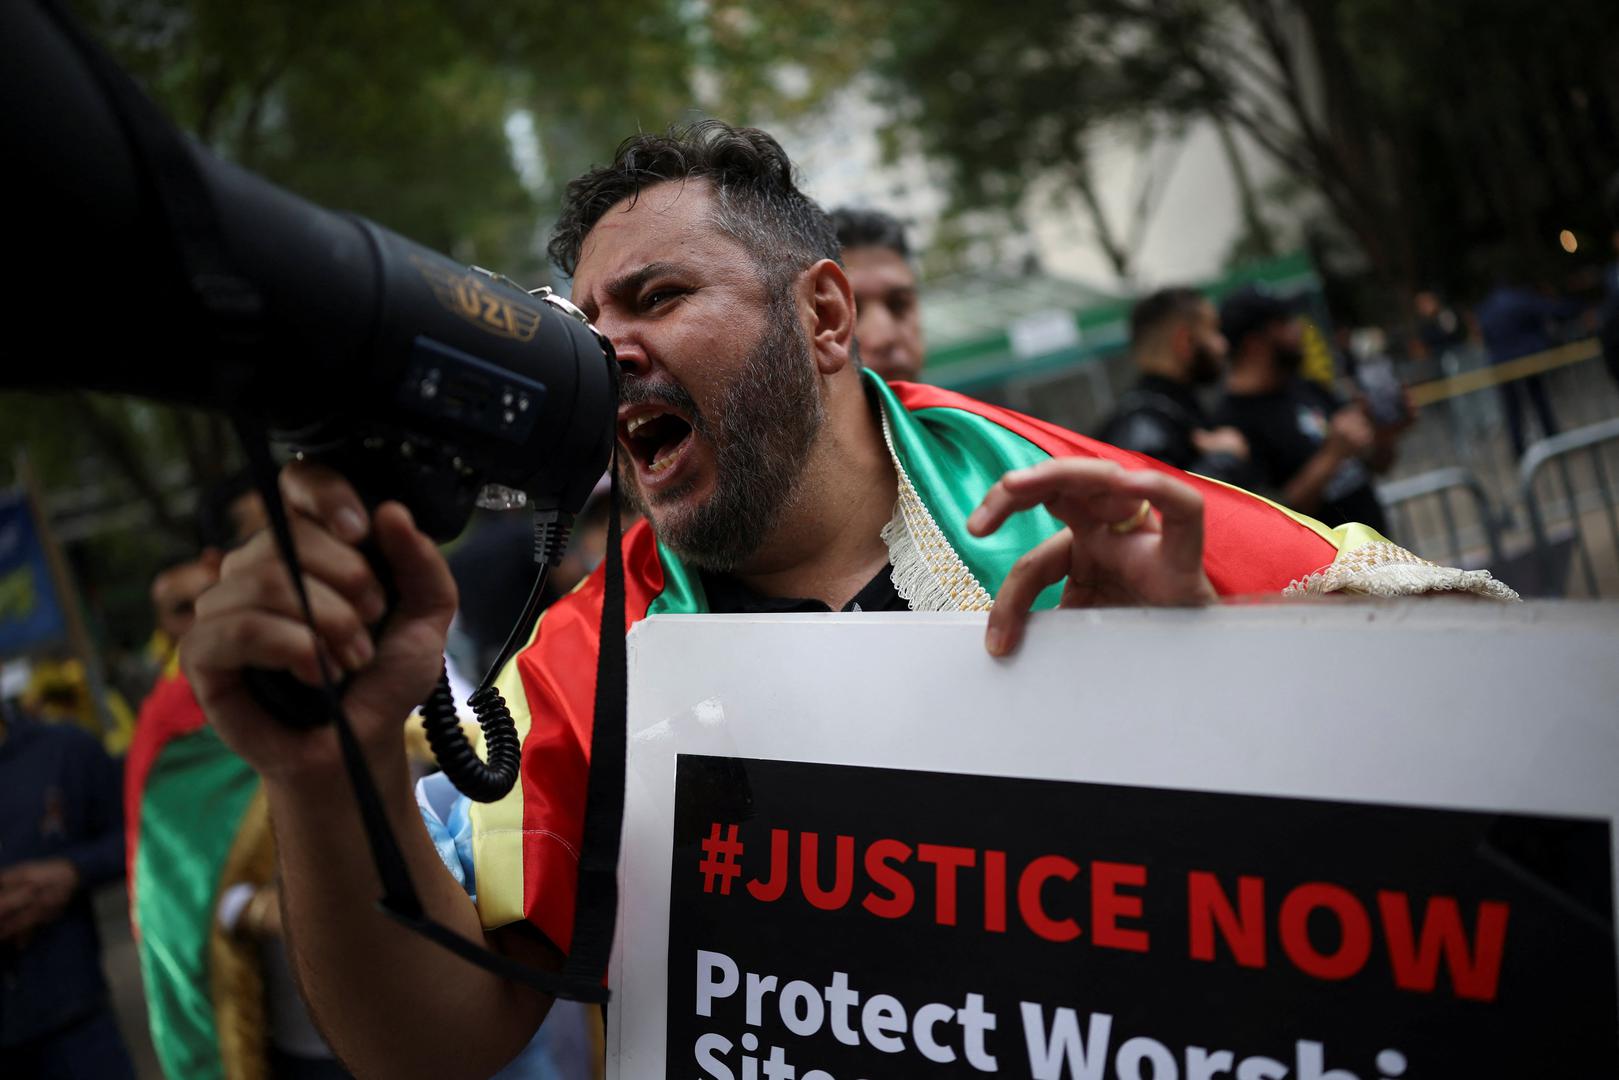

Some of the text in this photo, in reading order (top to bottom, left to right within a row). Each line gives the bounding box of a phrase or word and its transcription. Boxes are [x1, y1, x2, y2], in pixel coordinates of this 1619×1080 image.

[455, 283, 517, 336] UZI
[699, 822, 1509, 1000] #JUSTICE NOW
[696, 949, 998, 1072] Protect
[694, 1032, 870, 1080] Sit
